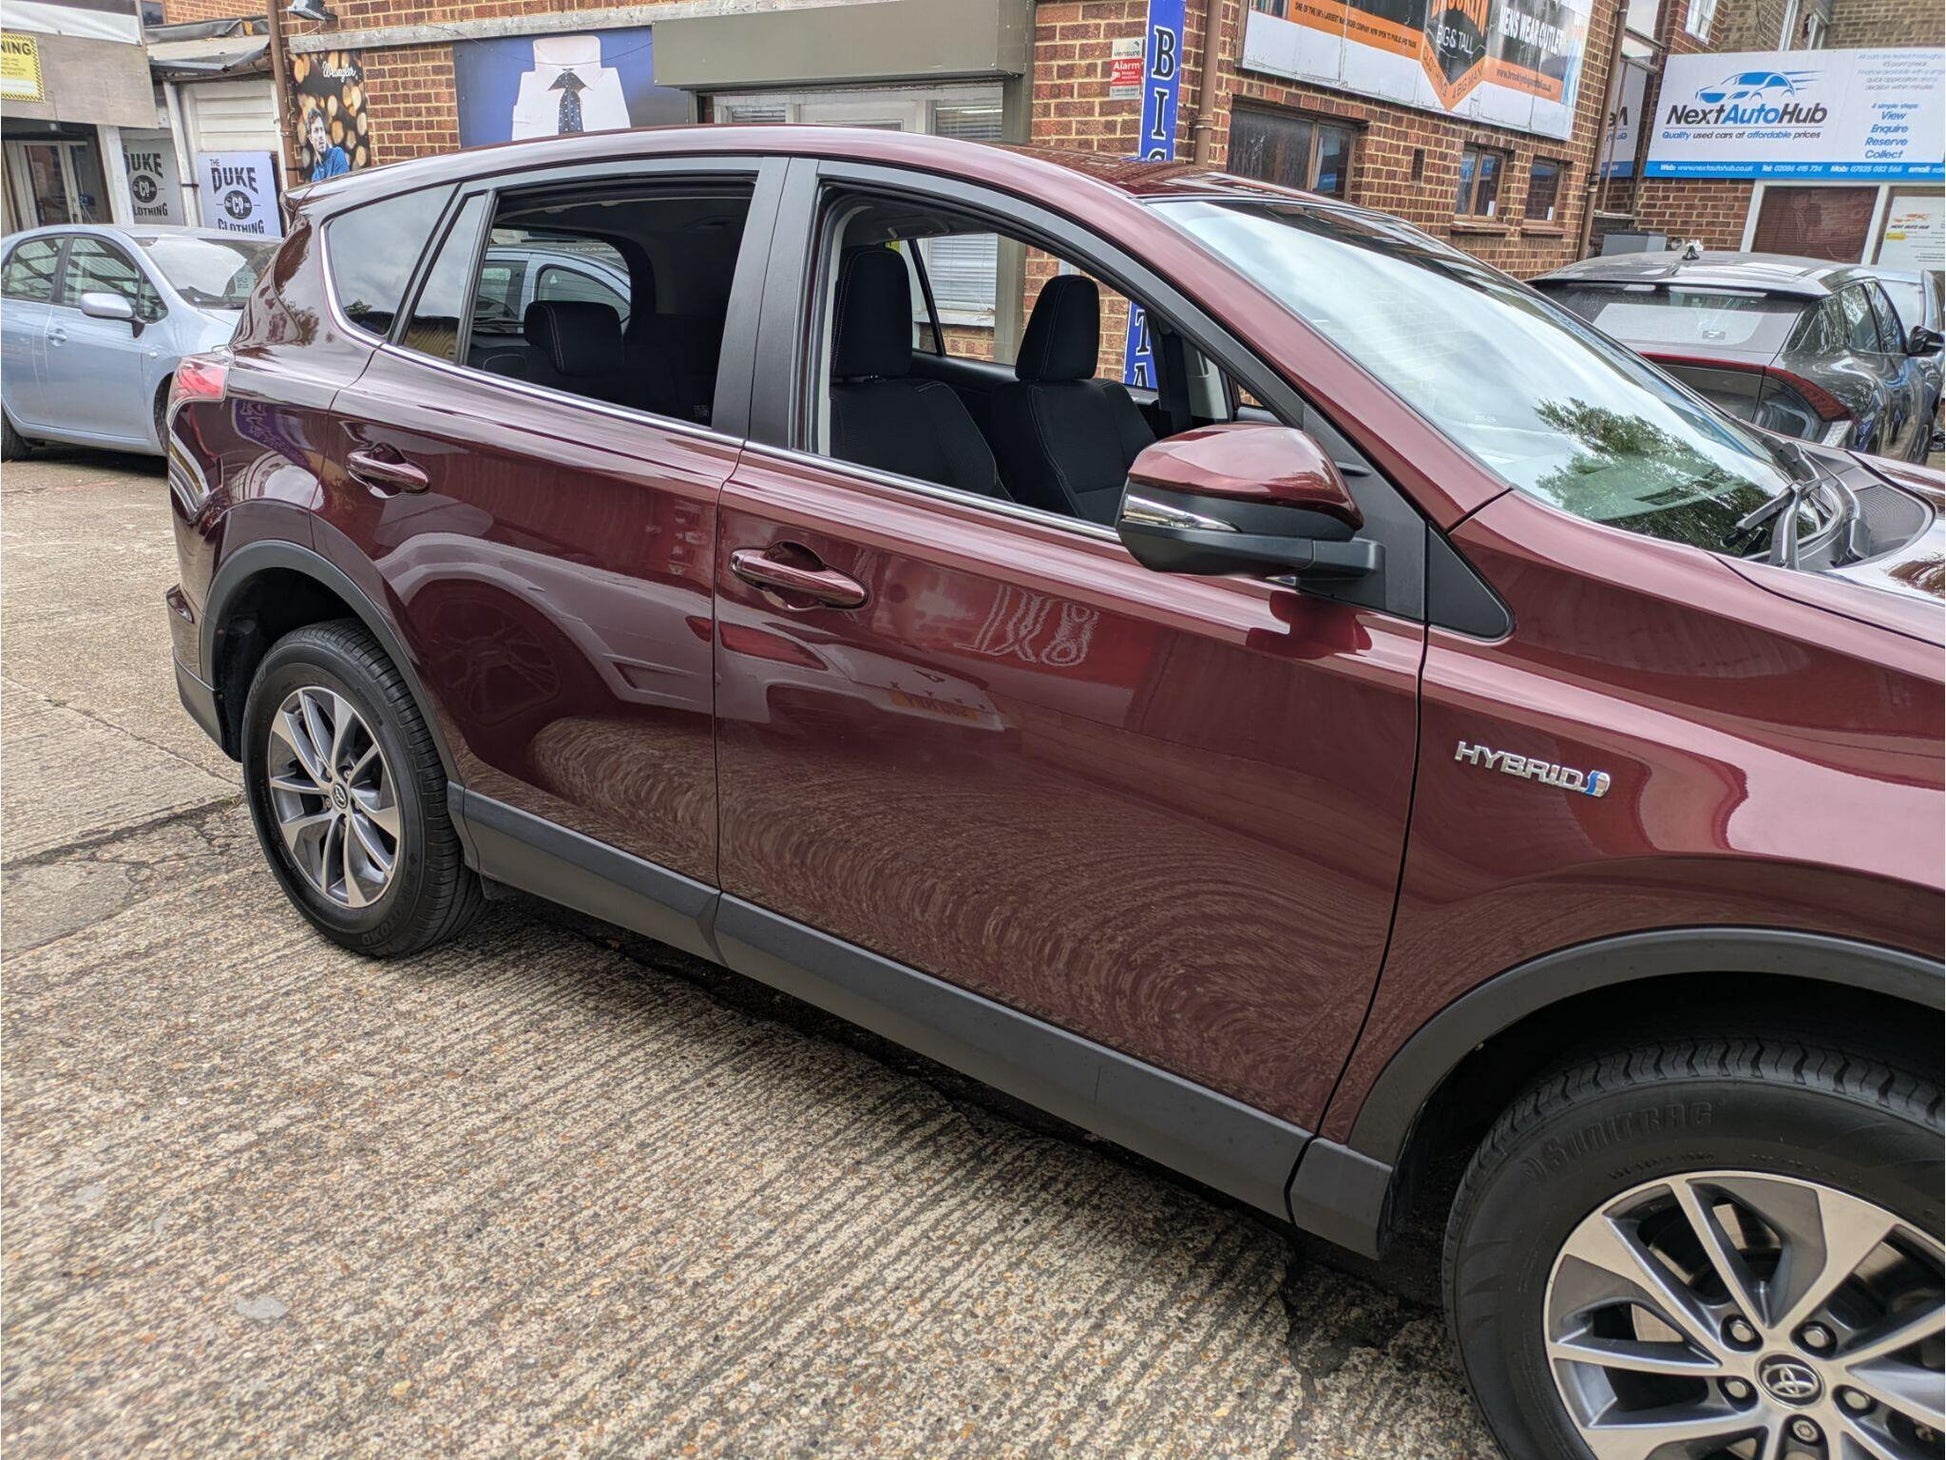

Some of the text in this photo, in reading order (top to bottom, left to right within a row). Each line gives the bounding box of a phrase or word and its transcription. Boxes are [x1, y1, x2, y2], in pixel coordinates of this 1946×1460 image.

[1498, 5, 1564, 54] MENS WEAR OUTLET
[1437, 24, 1450, 47] BIG
[1458, 32, 1474, 55] TALL
[1113, 61, 1140, 70] Alarm
[1666, 102, 1828, 125] NextAutoHub
[1880, 111, 1907, 120] View
[1662, 131, 1692, 141] Quality
[1693, 130, 1713, 139] used
[1735, 131, 1745, 139] at
[1747, 130, 1791, 139] affordable
[1793, 130, 1821, 140] prices
[1870, 124, 1909, 134] Enquire
[1864, 137, 1908, 146] Reserve
[1864, 149, 1903, 159] Collect
[210, 167, 259, 194] DUKE
[132, 202, 168, 217] LOTHING
[1454, 740, 1584, 791] HYBRID
